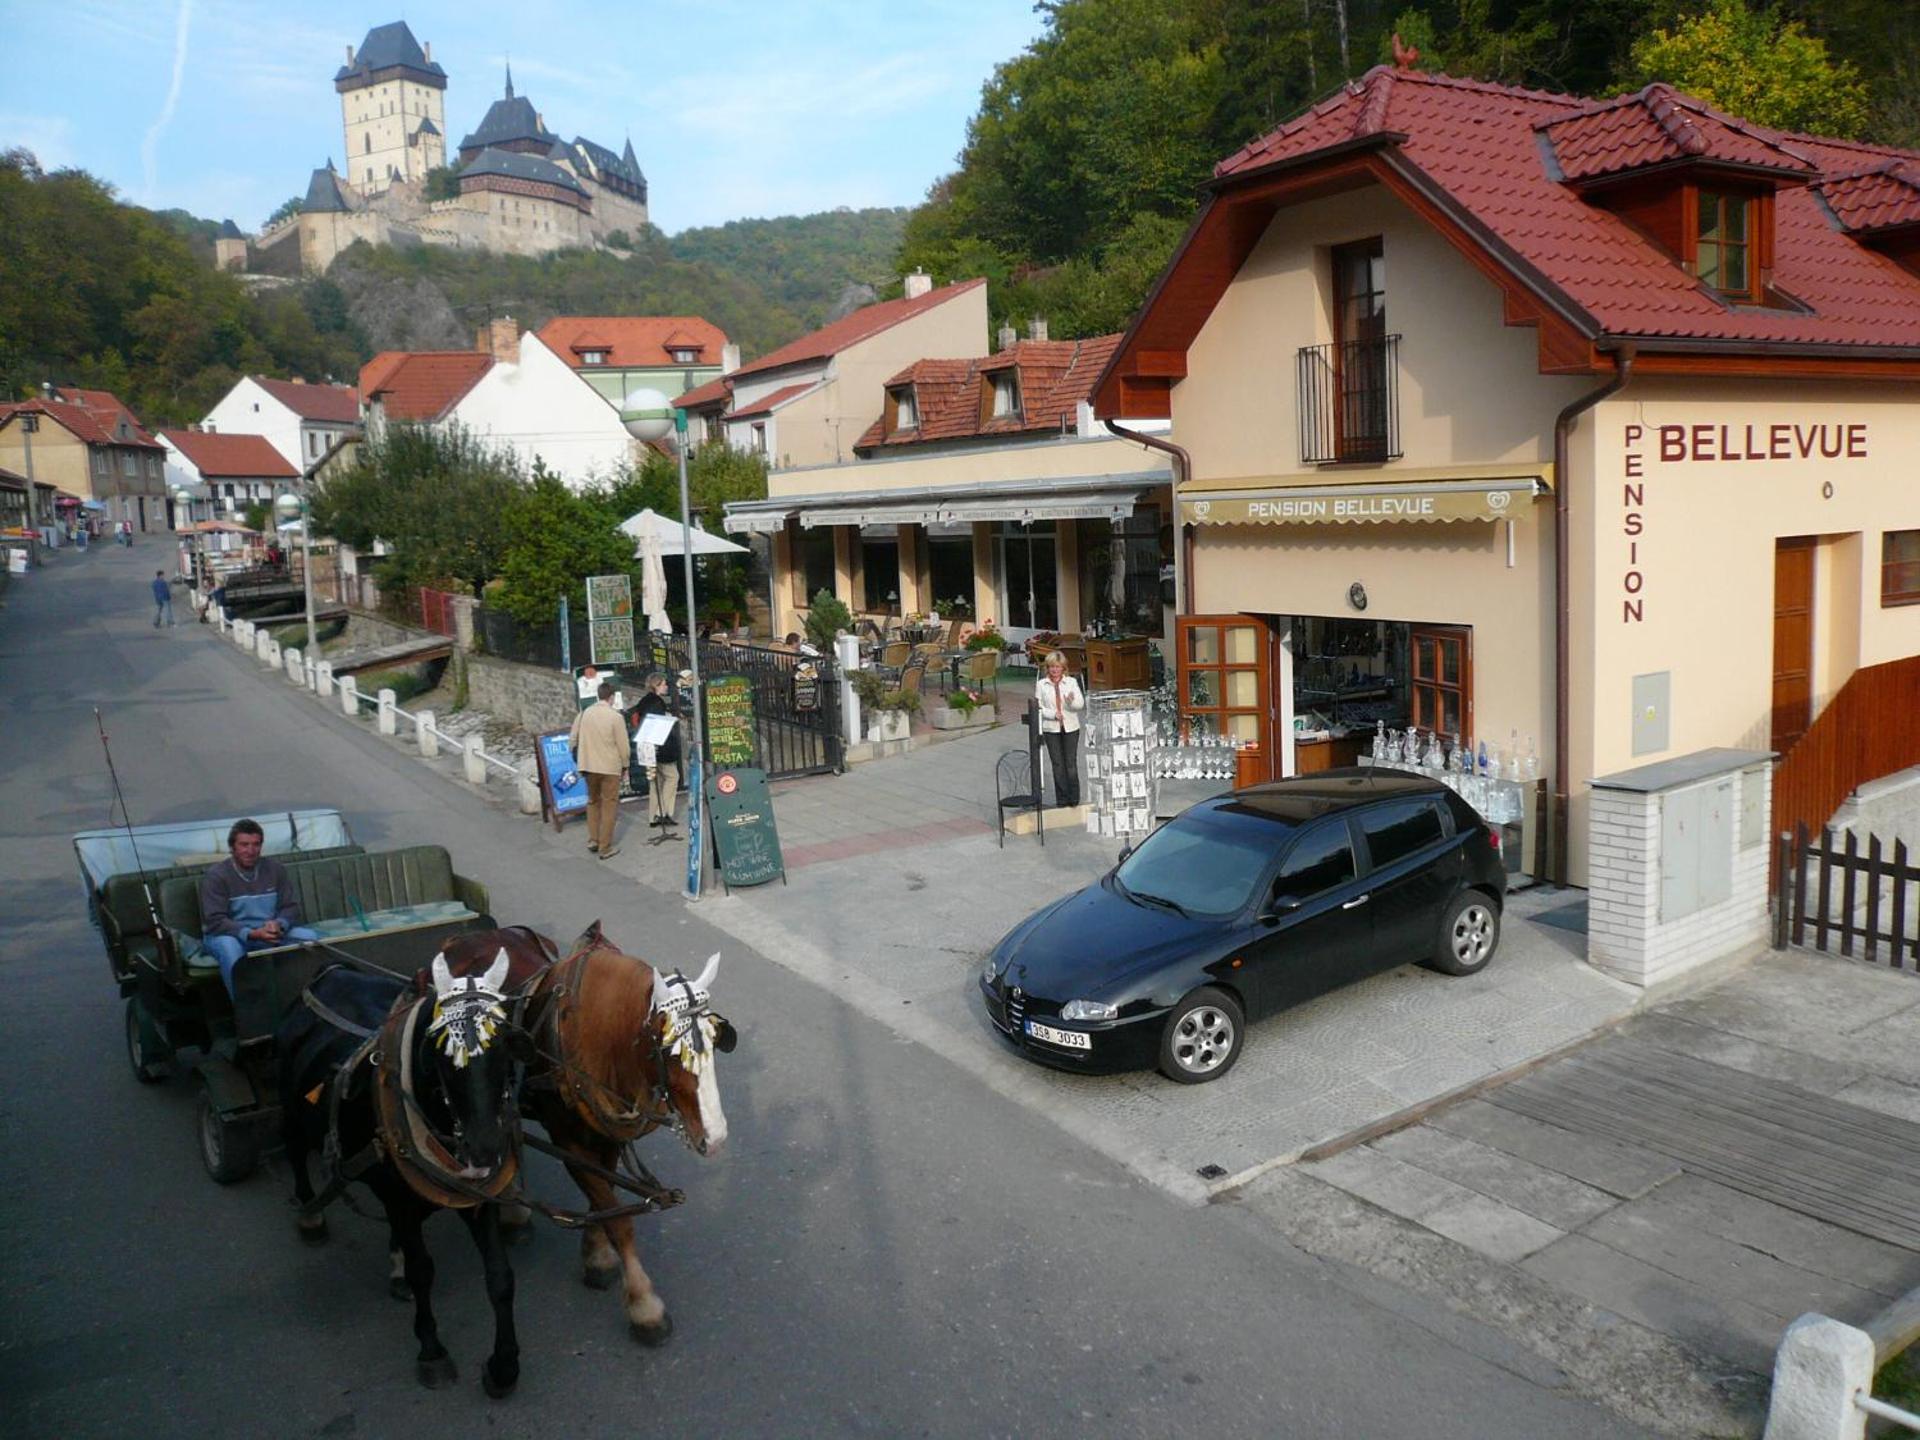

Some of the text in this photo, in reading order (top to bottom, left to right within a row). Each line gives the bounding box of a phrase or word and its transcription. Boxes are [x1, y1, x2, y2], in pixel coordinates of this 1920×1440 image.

[1660, 424, 1867, 462] BELLEVUE
[1248, 498, 1434, 517] PENSION BELLEVUE
[1623, 425, 1643, 623] PENSION
[713, 752, 744, 764] PASTA
[1033, 1024, 1085, 1046] 3S8 3033
